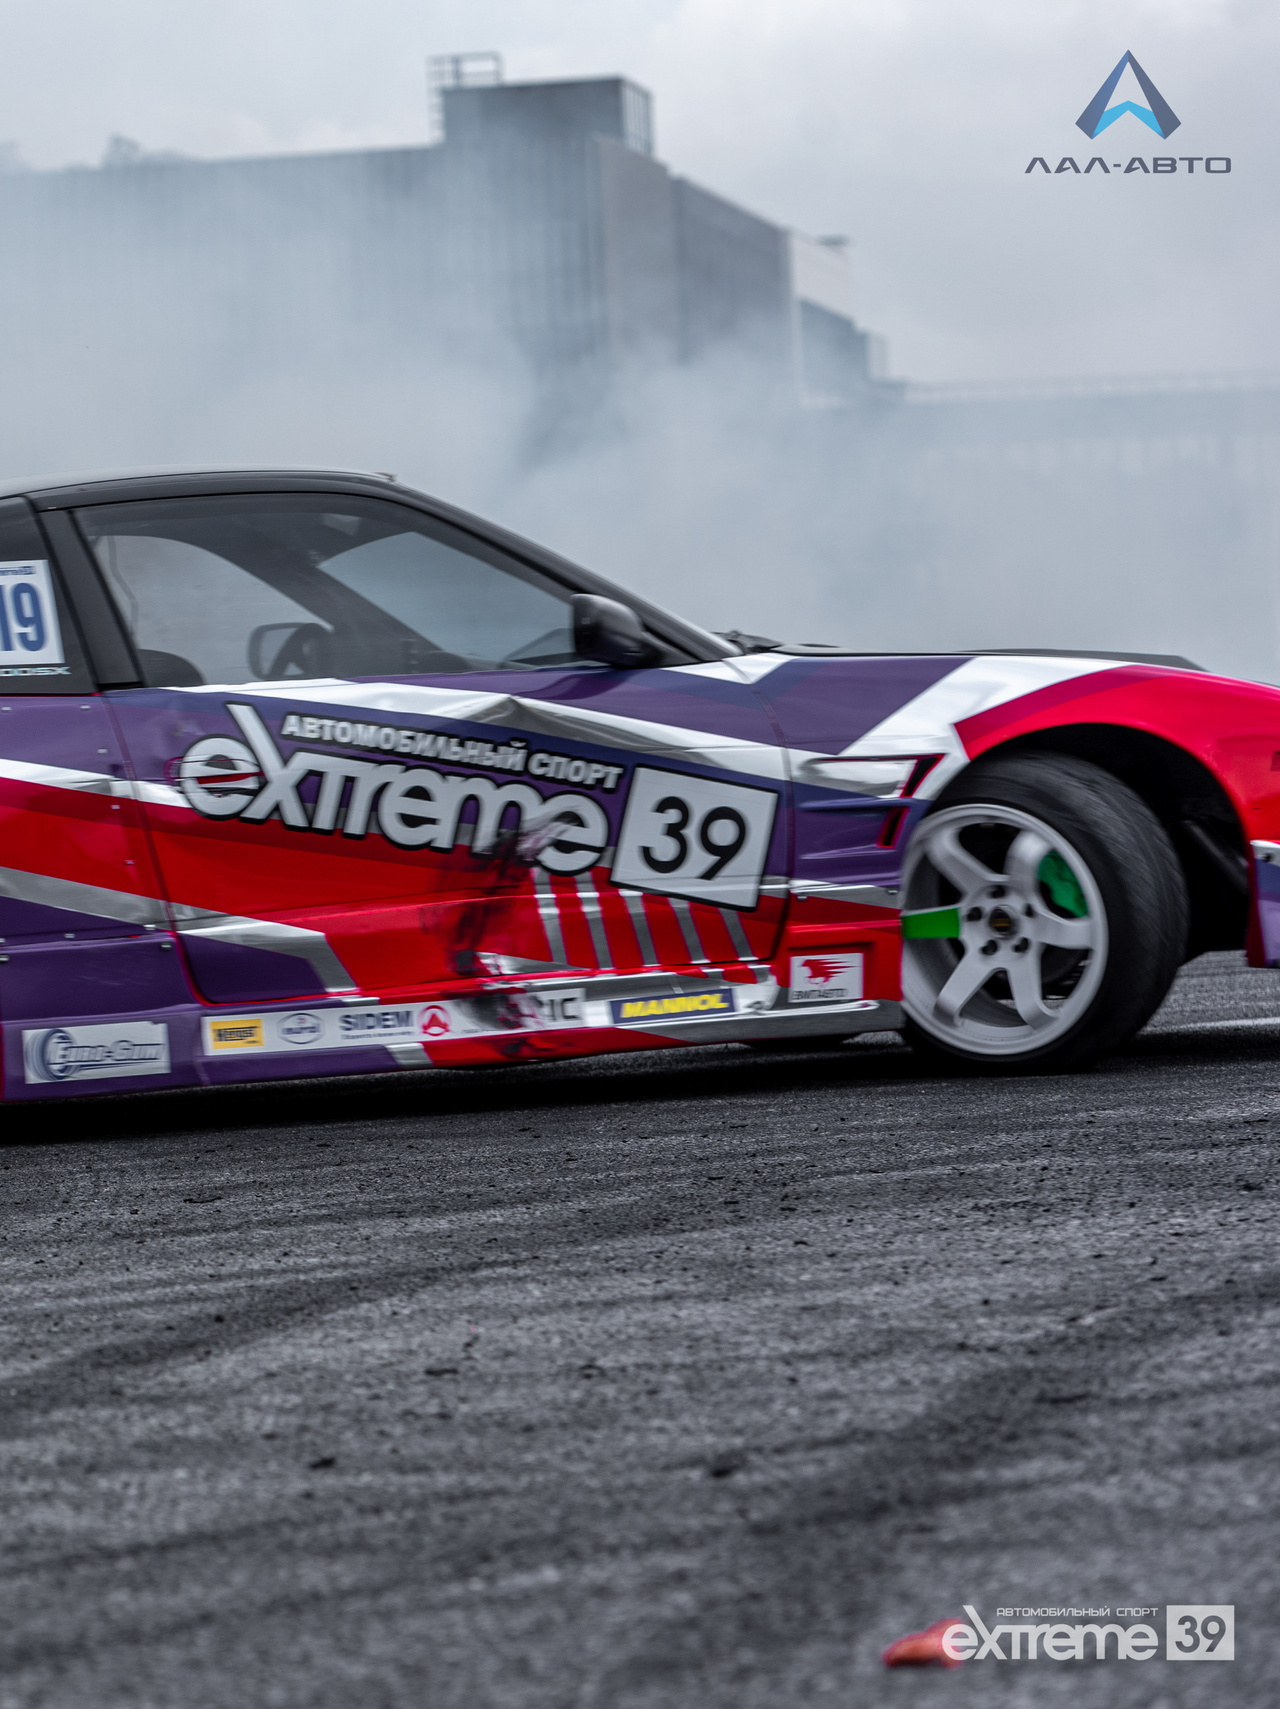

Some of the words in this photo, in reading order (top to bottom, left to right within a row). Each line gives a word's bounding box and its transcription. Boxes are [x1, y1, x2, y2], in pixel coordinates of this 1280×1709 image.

[281, 714, 528, 772] АВТОМОБИЛЬНЫЙ
[528, 752, 624, 790] СПОРТ
[641, 795, 747, 881] 39
[621, 993, 729, 1018] MANNOL
